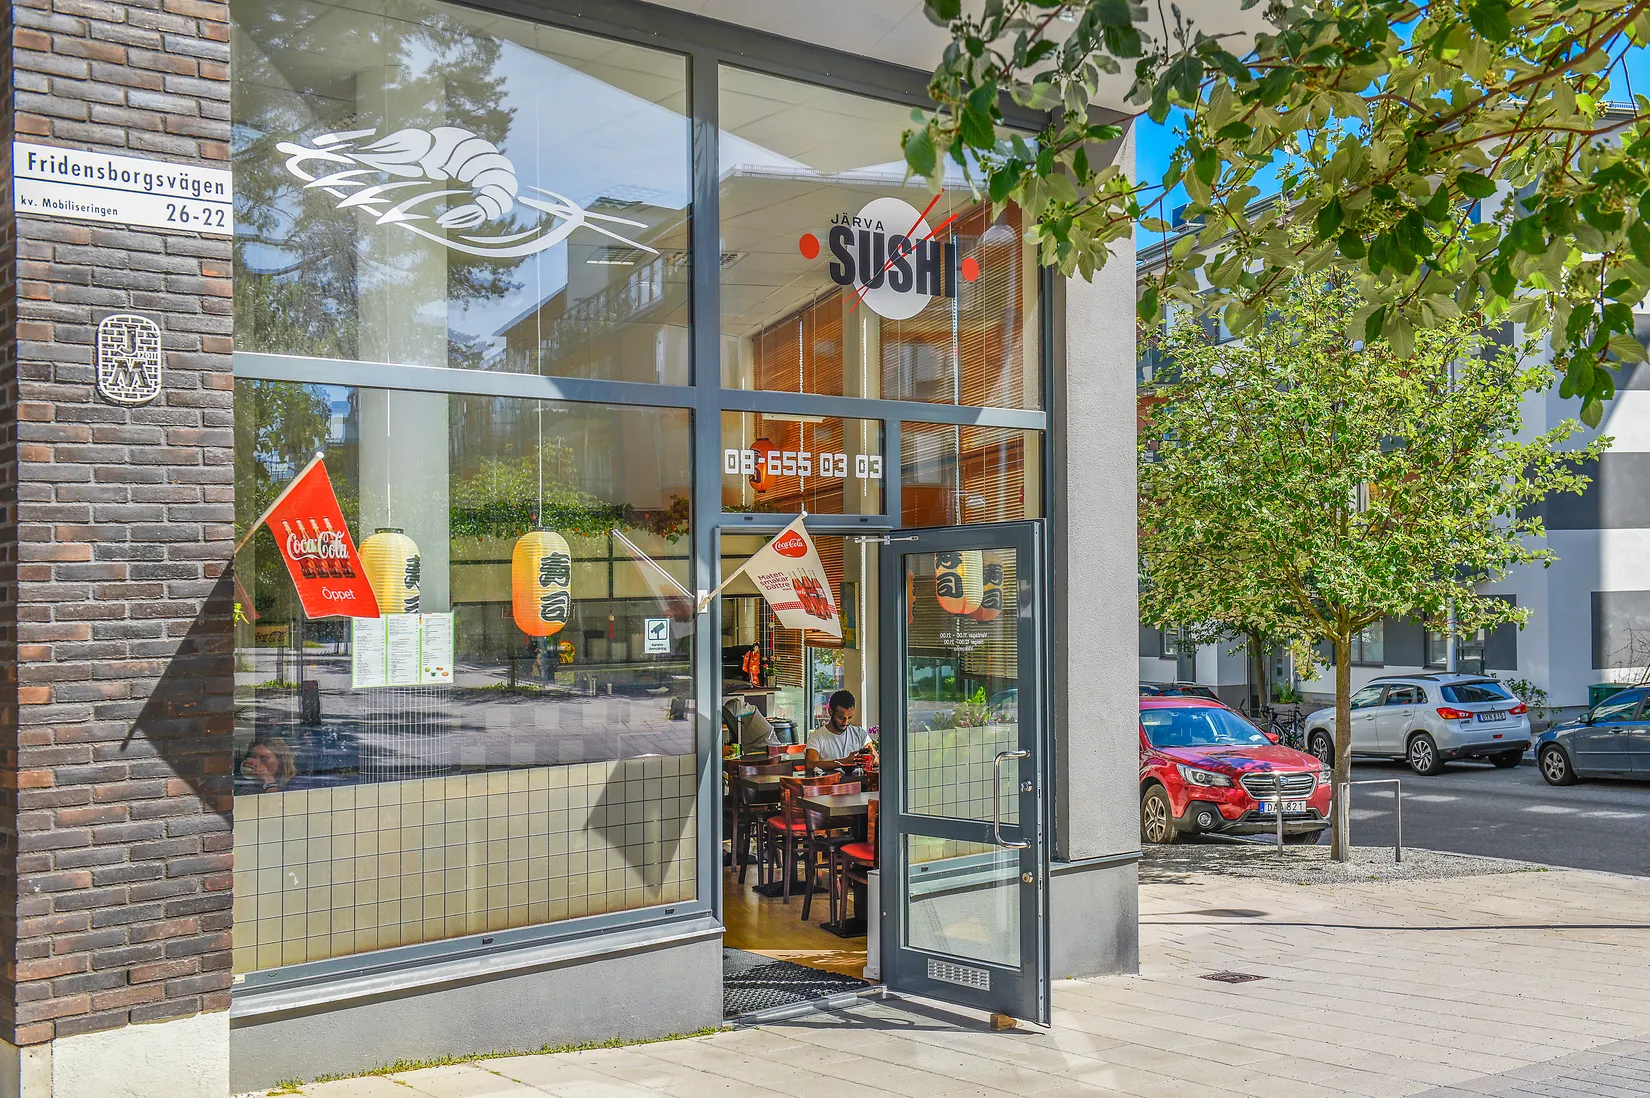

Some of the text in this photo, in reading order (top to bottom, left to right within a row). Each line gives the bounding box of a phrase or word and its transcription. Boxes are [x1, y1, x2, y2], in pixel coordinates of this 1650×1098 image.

[27, 151, 225, 197] Fridensborgsvägen
[20, 194, 118, 217] kv. Mobiliseringen
[166, 203, 225, 228] 26-22
[830, 212, 885, 232] JÄRVA
[828, 225, 956, 299] SUSHI
[724, 448, 812, 477] 08-655
[819, 452, 848, 478] 03
[855, 454, 882, 479] 03
[286, 530, 349, 561] Coca-Cola
[775, 538, 803, 551] Coca-Cola
[757, 571, 785, 581] Maten
[760, 575, 789, 587] smakar
[764, 581, 791, 591] bättre
[321, 586, 357, 602] Öppet
[1286, 802, 1303, 811] 821
